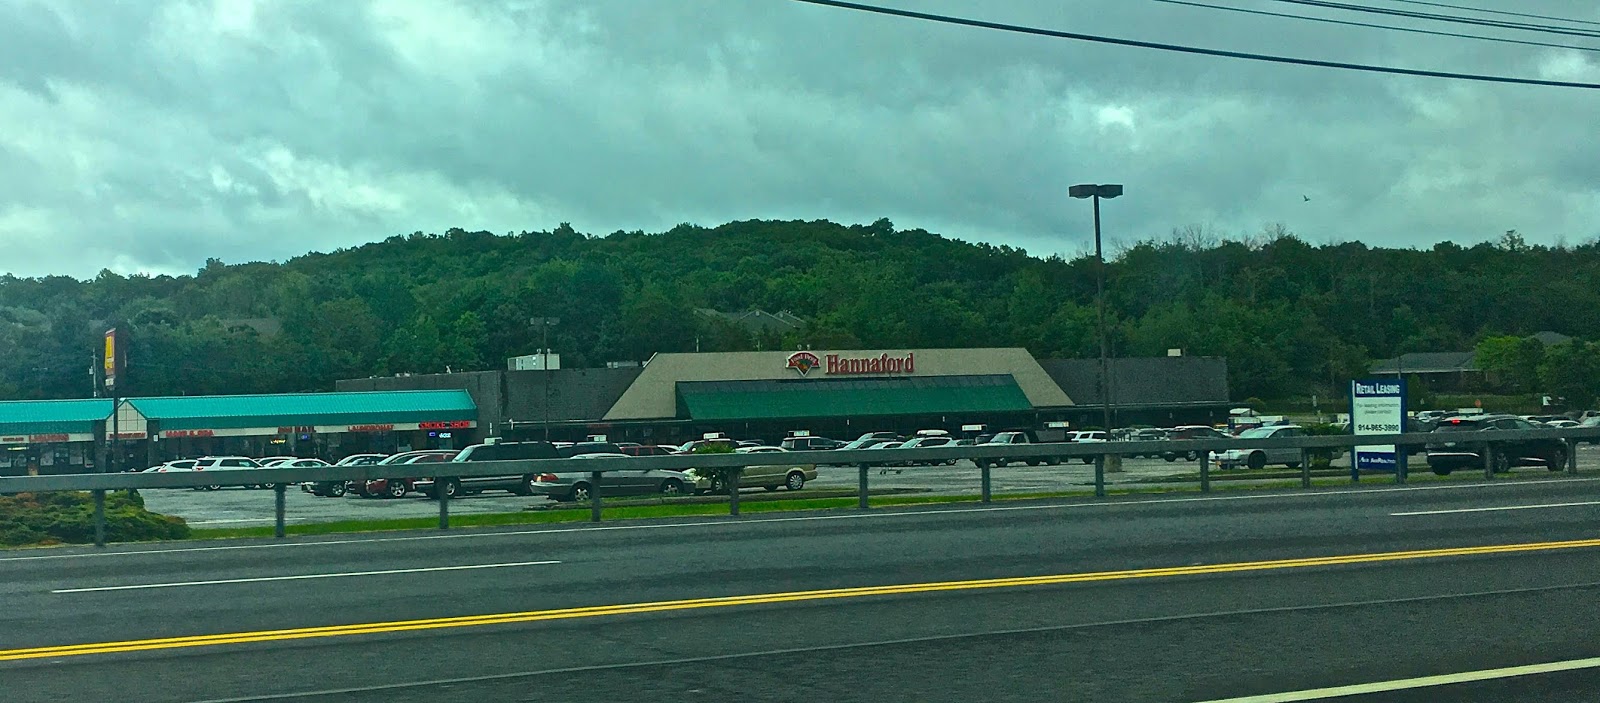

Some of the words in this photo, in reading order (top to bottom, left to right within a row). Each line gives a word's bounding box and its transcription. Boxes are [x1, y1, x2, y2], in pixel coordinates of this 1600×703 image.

[825, 352, 914, 374] Hannaford
[1356, 383, 1375, 394] RETAIL
[1376, 383, 1400, 394] LEASING
[419, 421, 446, 429] SMOKE
[449, 421, 470, 429] SHOP
